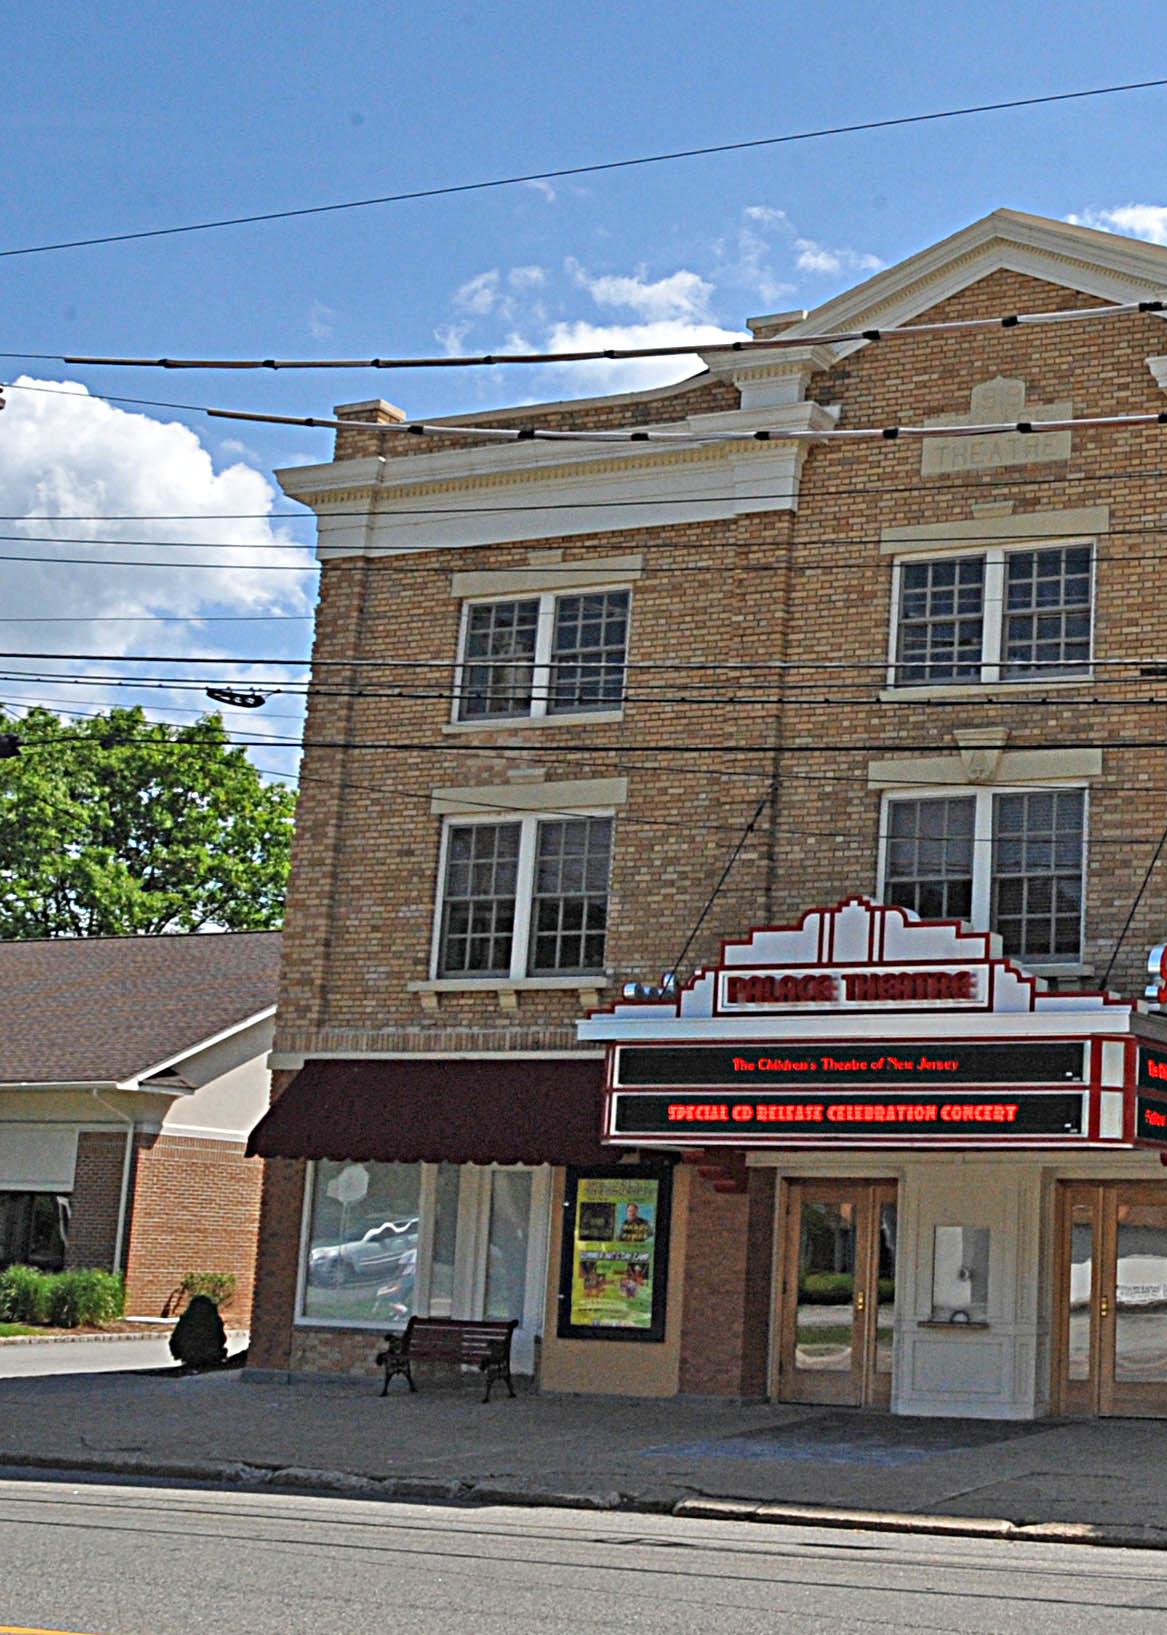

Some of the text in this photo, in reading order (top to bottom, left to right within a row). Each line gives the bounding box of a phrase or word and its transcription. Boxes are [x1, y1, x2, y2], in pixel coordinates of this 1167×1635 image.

[935, 433, 1060, 468] THEATRE
[727, 971, 976, 1003] PALACE THEATRE
[732, 1056, 959, 1072] The Children's Theatre of New Jersey
[667, 1104, 1019, 1122] SPECIAL CD RELEASE CELEBRATION CONCERT
